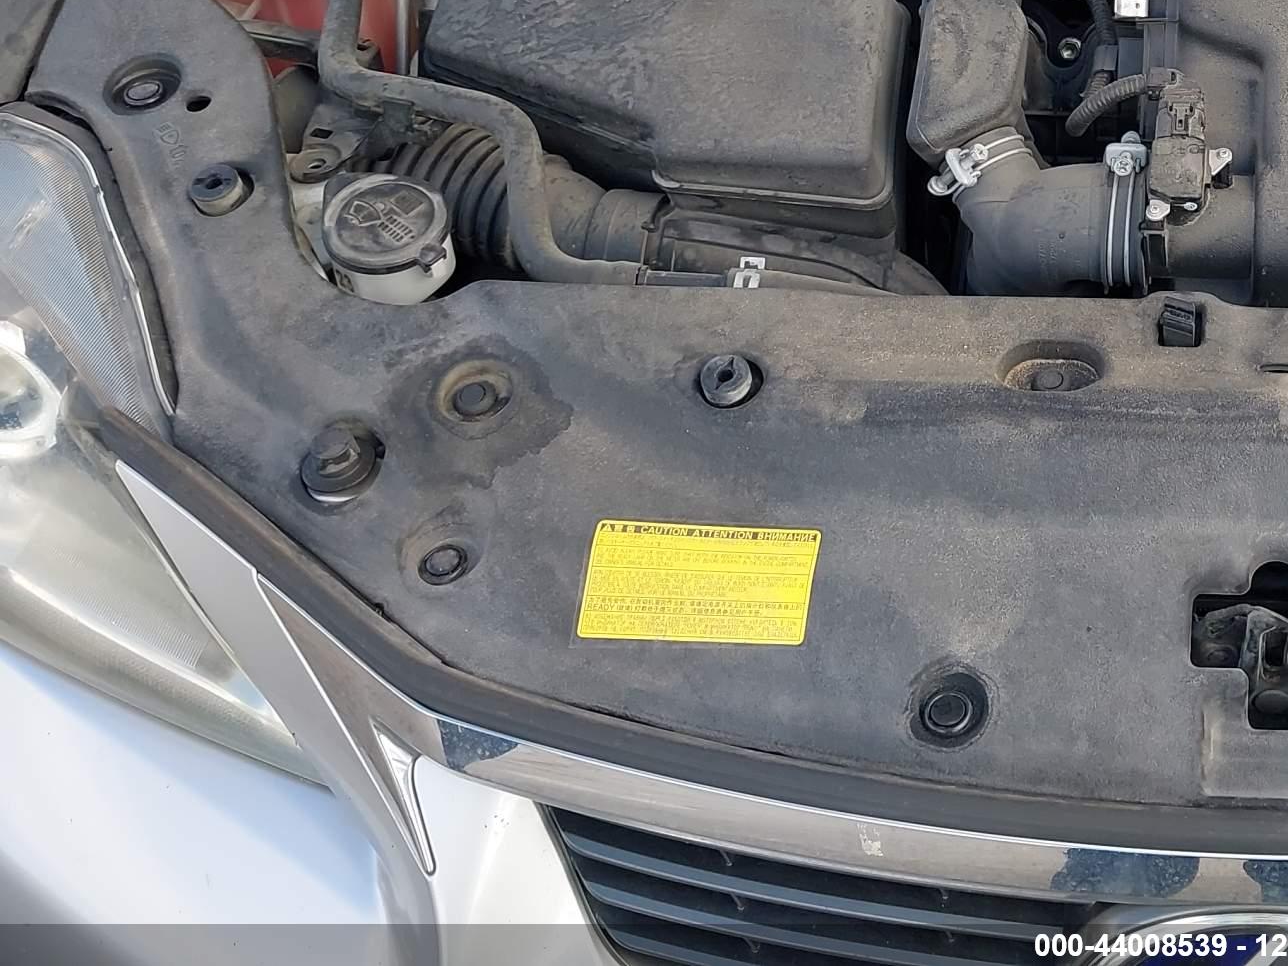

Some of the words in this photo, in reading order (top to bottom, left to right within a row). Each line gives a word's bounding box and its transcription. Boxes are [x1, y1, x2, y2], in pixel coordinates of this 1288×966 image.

[640, 525, 688, 536] CAUTION
[692, 528, 754, 540] ATTENTION
[757, 531, 816, 542] ВНИМАНИЕ
